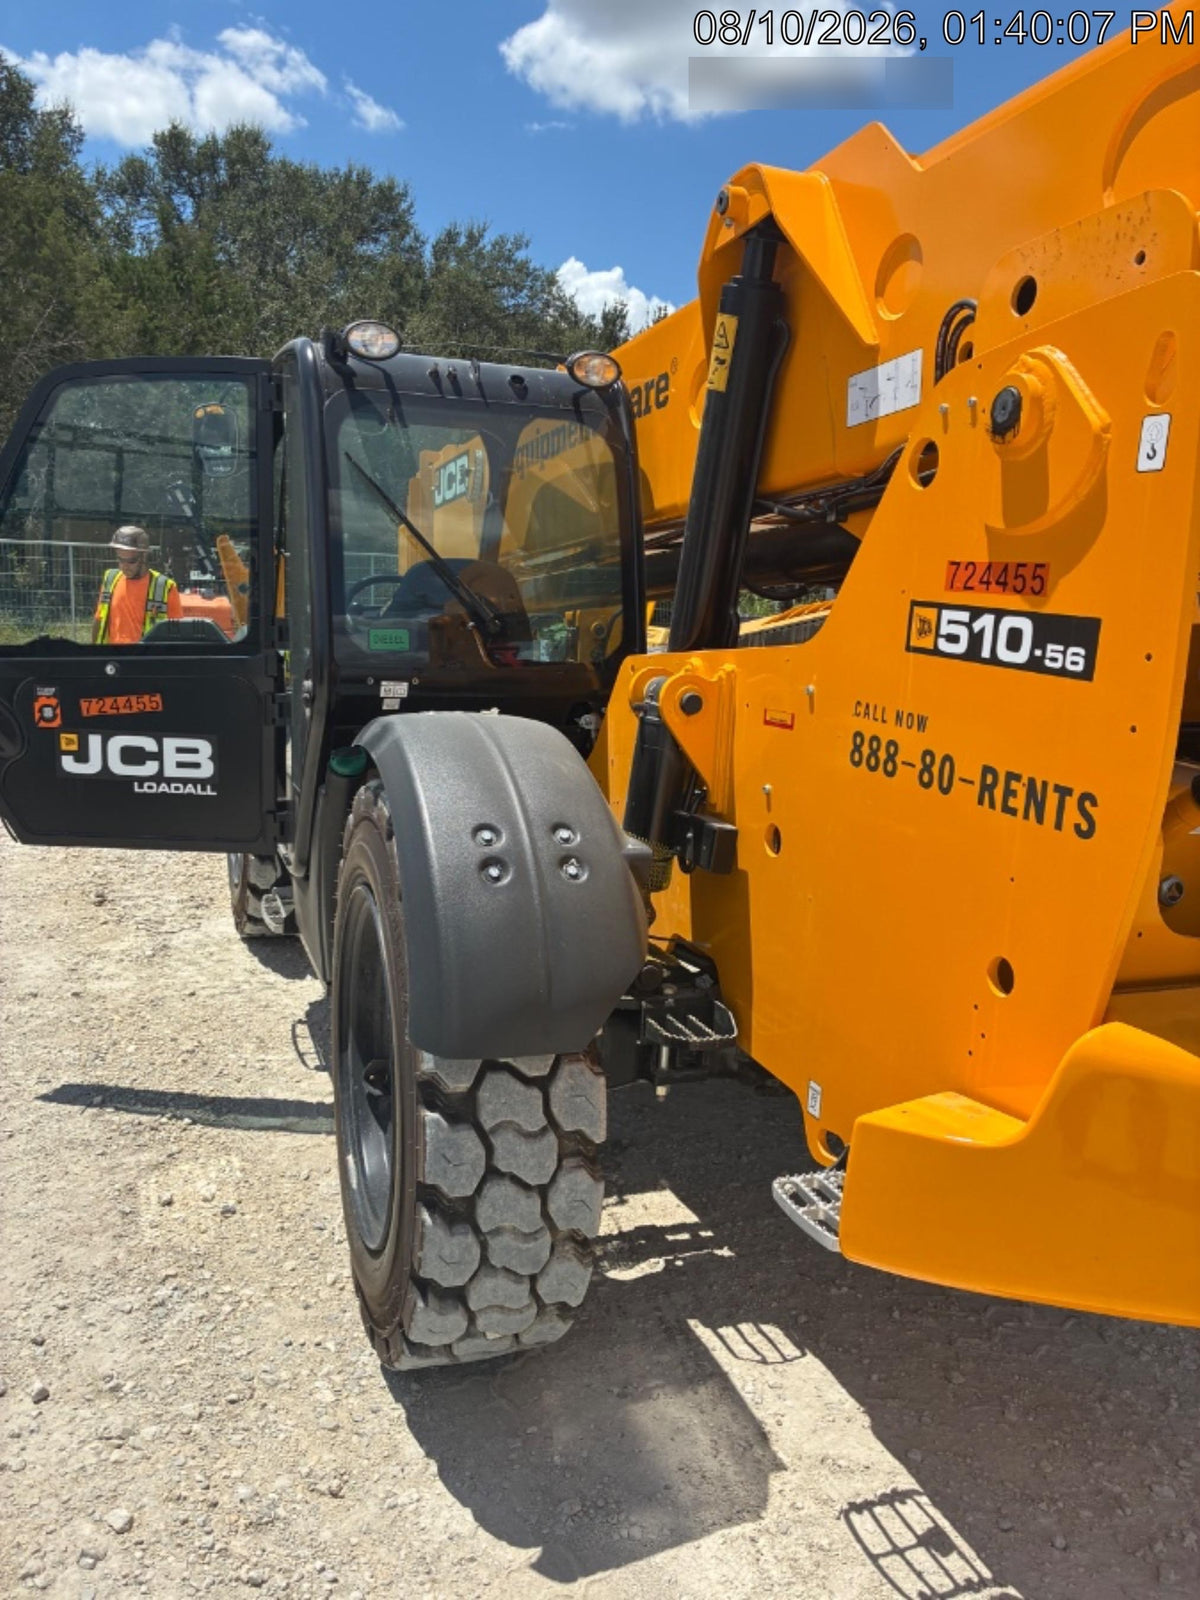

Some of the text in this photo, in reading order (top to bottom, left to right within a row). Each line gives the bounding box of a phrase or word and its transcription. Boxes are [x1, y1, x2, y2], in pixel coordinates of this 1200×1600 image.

[948, 561, 1046, 595] 724455
[83, 695, 161, 715] 724455
[853, 700, 929, 733] CALL NOW
[61, 734, 214, 779] JCB
[134, 782, 217, 795] LOADALL
[850, 730, 1099, 840] 888-80-RENTS
